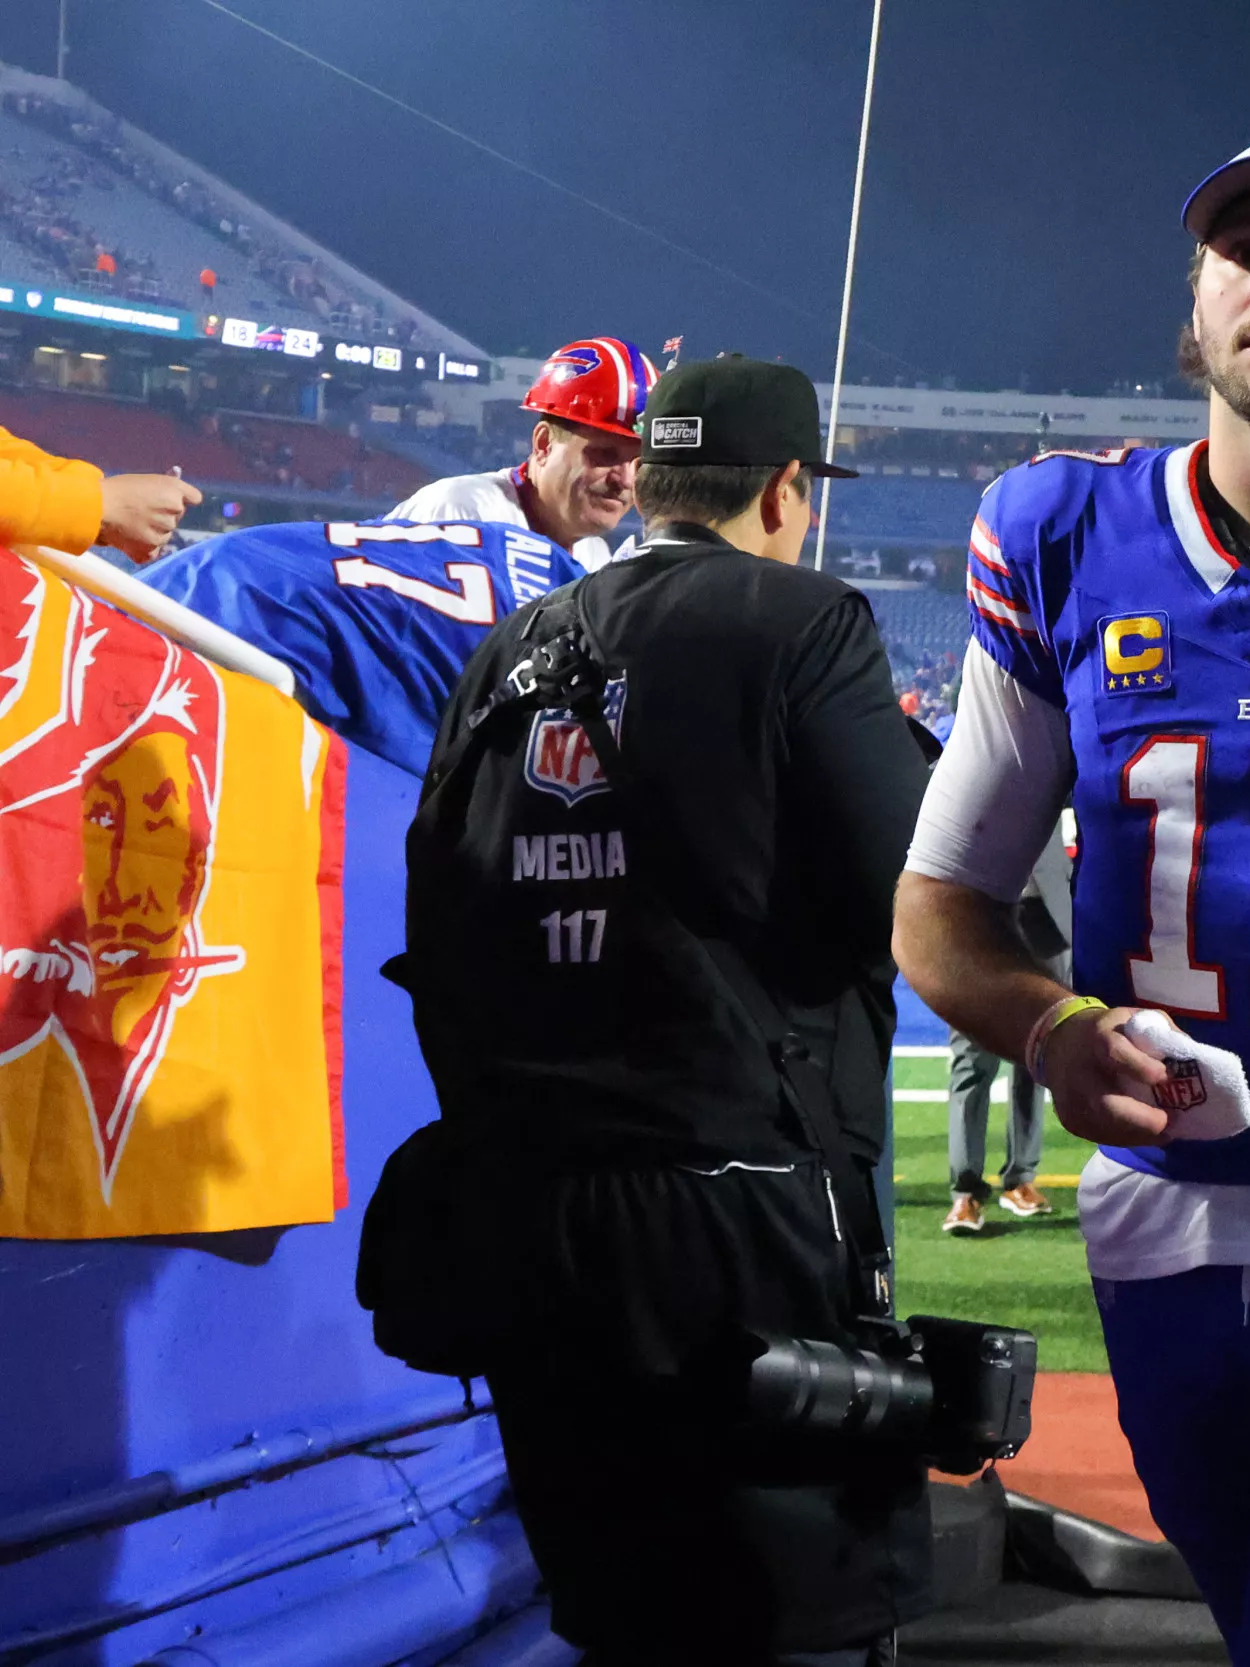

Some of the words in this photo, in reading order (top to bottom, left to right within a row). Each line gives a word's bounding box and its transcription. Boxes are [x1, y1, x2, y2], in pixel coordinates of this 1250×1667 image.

[292, 335, 311, 350] 24
[664, 428, 698, 440] CATCH
[325, 522, 497, 625] 17
[503, 529, 552, 610] ALLE
[1103, 616, 1163, 675] C
[536, 724, 606, 786] NF
[512, 830, 627, 882] MEDIA
[540, 908, 608, 964] 117
[1157, 1078, 1203, 1110] NFL
